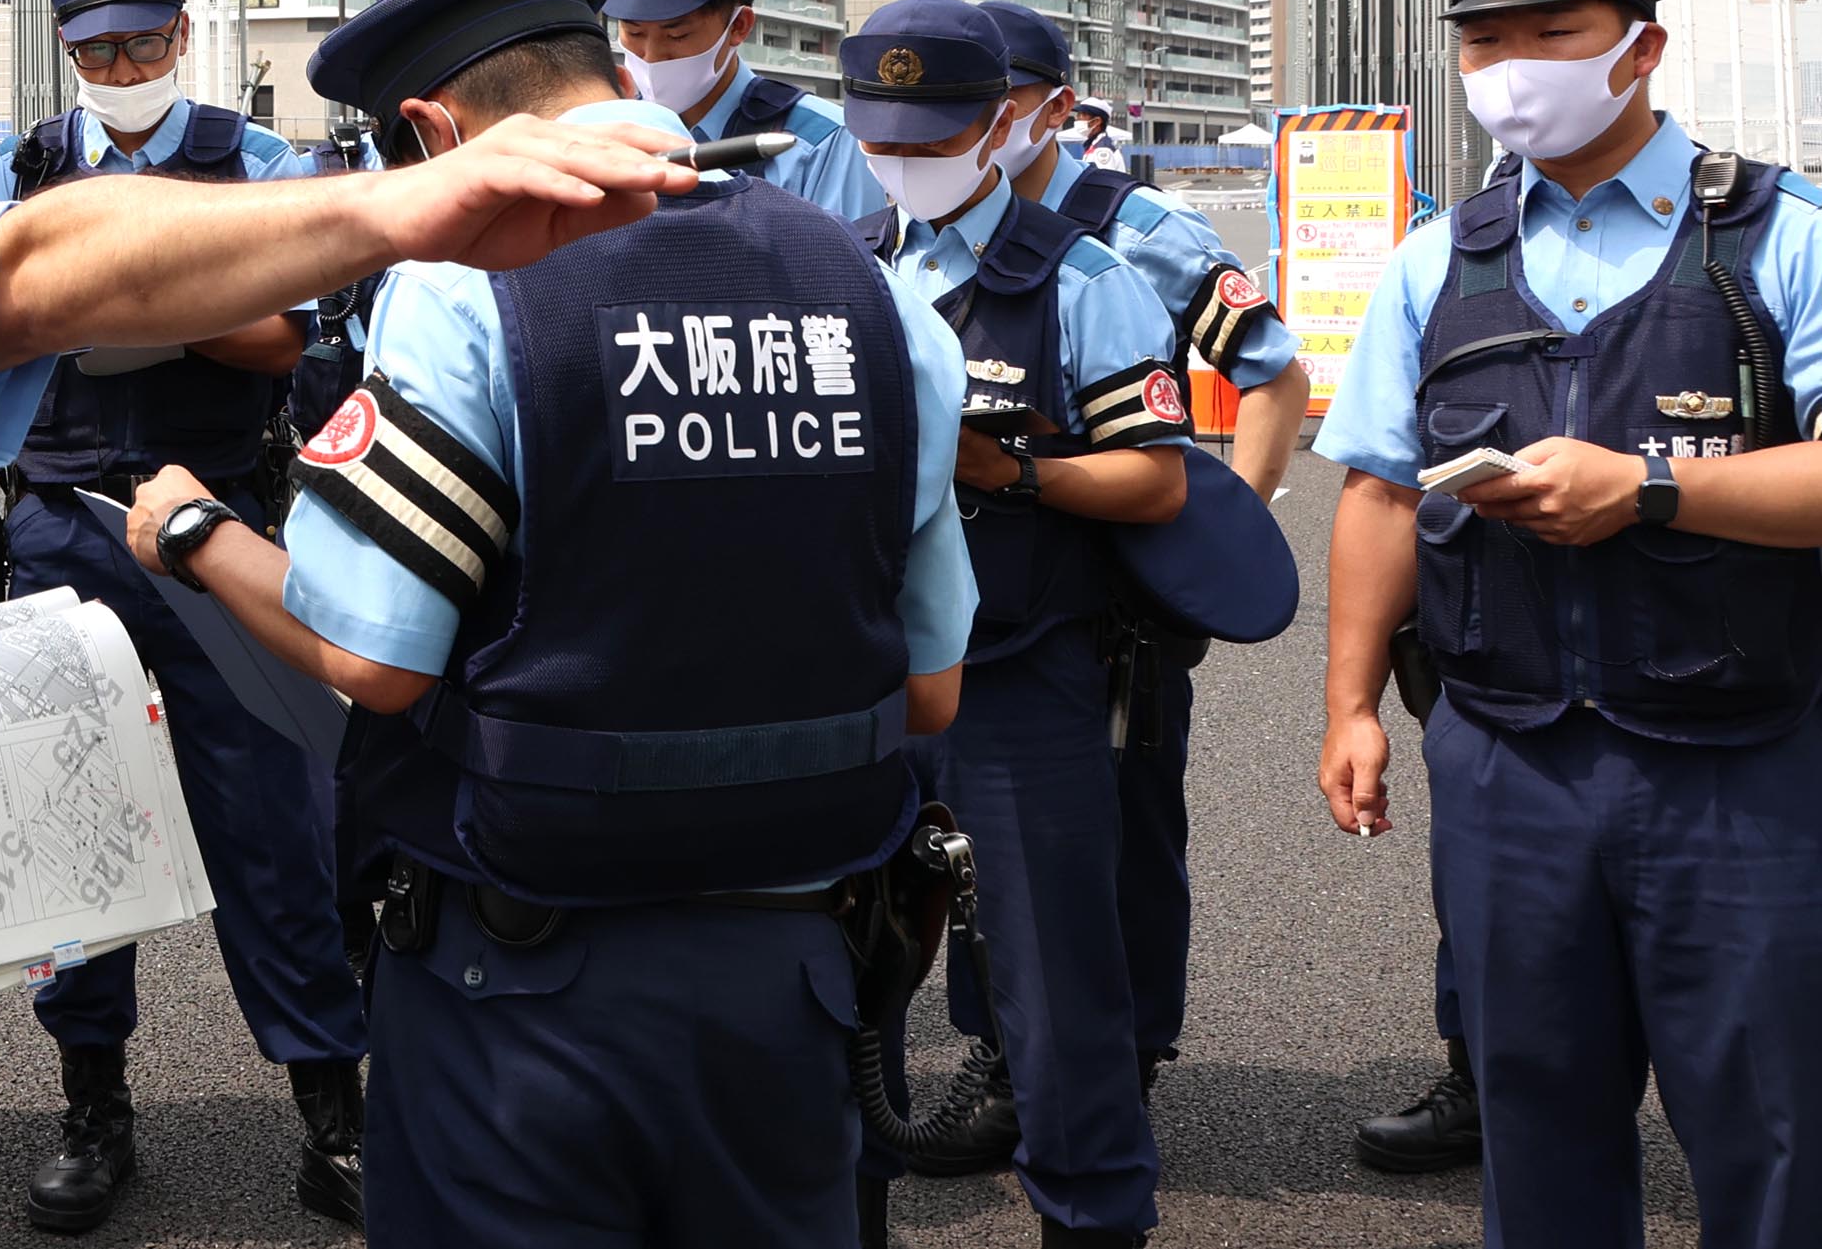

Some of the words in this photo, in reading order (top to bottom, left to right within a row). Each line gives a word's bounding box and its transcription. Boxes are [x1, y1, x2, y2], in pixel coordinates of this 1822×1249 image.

[1298, 203, 1385, 217] 立入禁止
[614, 312, 856, 396] 大阪府警
[625, 410, 866, 462] POLICE
